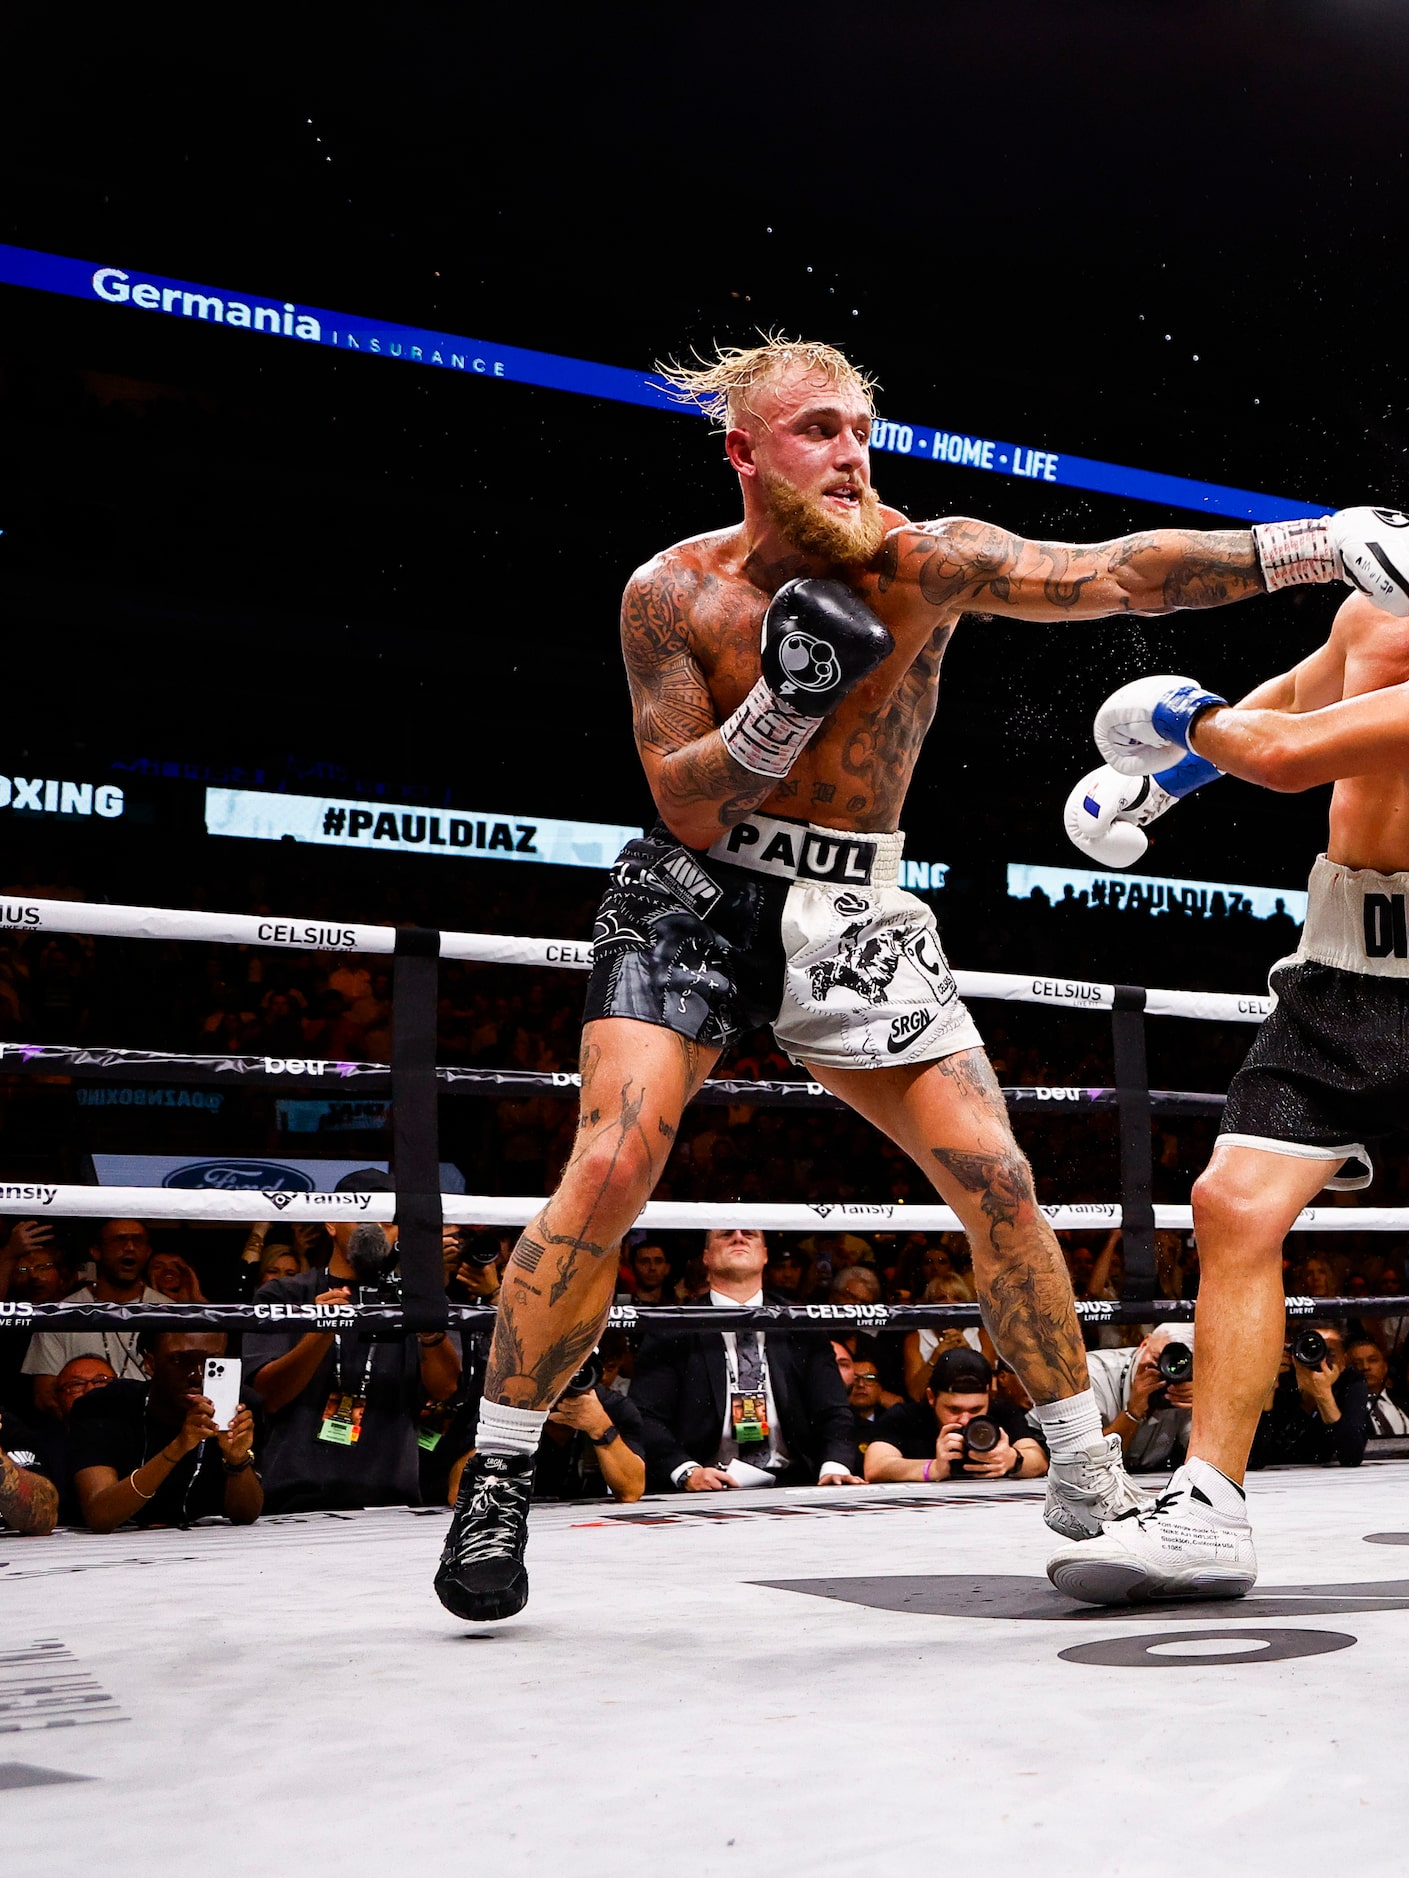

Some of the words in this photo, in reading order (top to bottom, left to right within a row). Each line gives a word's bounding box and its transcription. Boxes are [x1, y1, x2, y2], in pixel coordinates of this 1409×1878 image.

[92, 267, 321, 342] Germania
[332, 330, 506, 377] INSURANCE
[869, 420, 913, 453] UTO
[932, 432, 996, 470] HOME
[1012, 447, 1059, 481] LIFE
[321, 806, 538, 854] #PAULDIAZ
[726, 822, 867, 879] PAUL
[898, 859, 950, 890] ING
[546, 945, 595, 964] CELS
[890, 1007, 932, 1038] SRGN
[264, 1057, 329, 1076] betr
[552, 1072, 582, 1087] be
[1036, 1086, 1082, 1101] betr
[1084, 1313, 1098, 1321] LIVE
[1100, 1313, 1112, 1321] FIT
[1290, 1307, 1303, 1315] LIVE
[1304, 1306, 1315, 1315] FIT
[15, 1318, 32, 1327] FIT
[317, 1319, 336, 1328] LIVE
[339, 1319, 355, 1328] FIT
[623, 1320, 636, 1328] FIT
[874, 1318, 887, 1326] FIT
